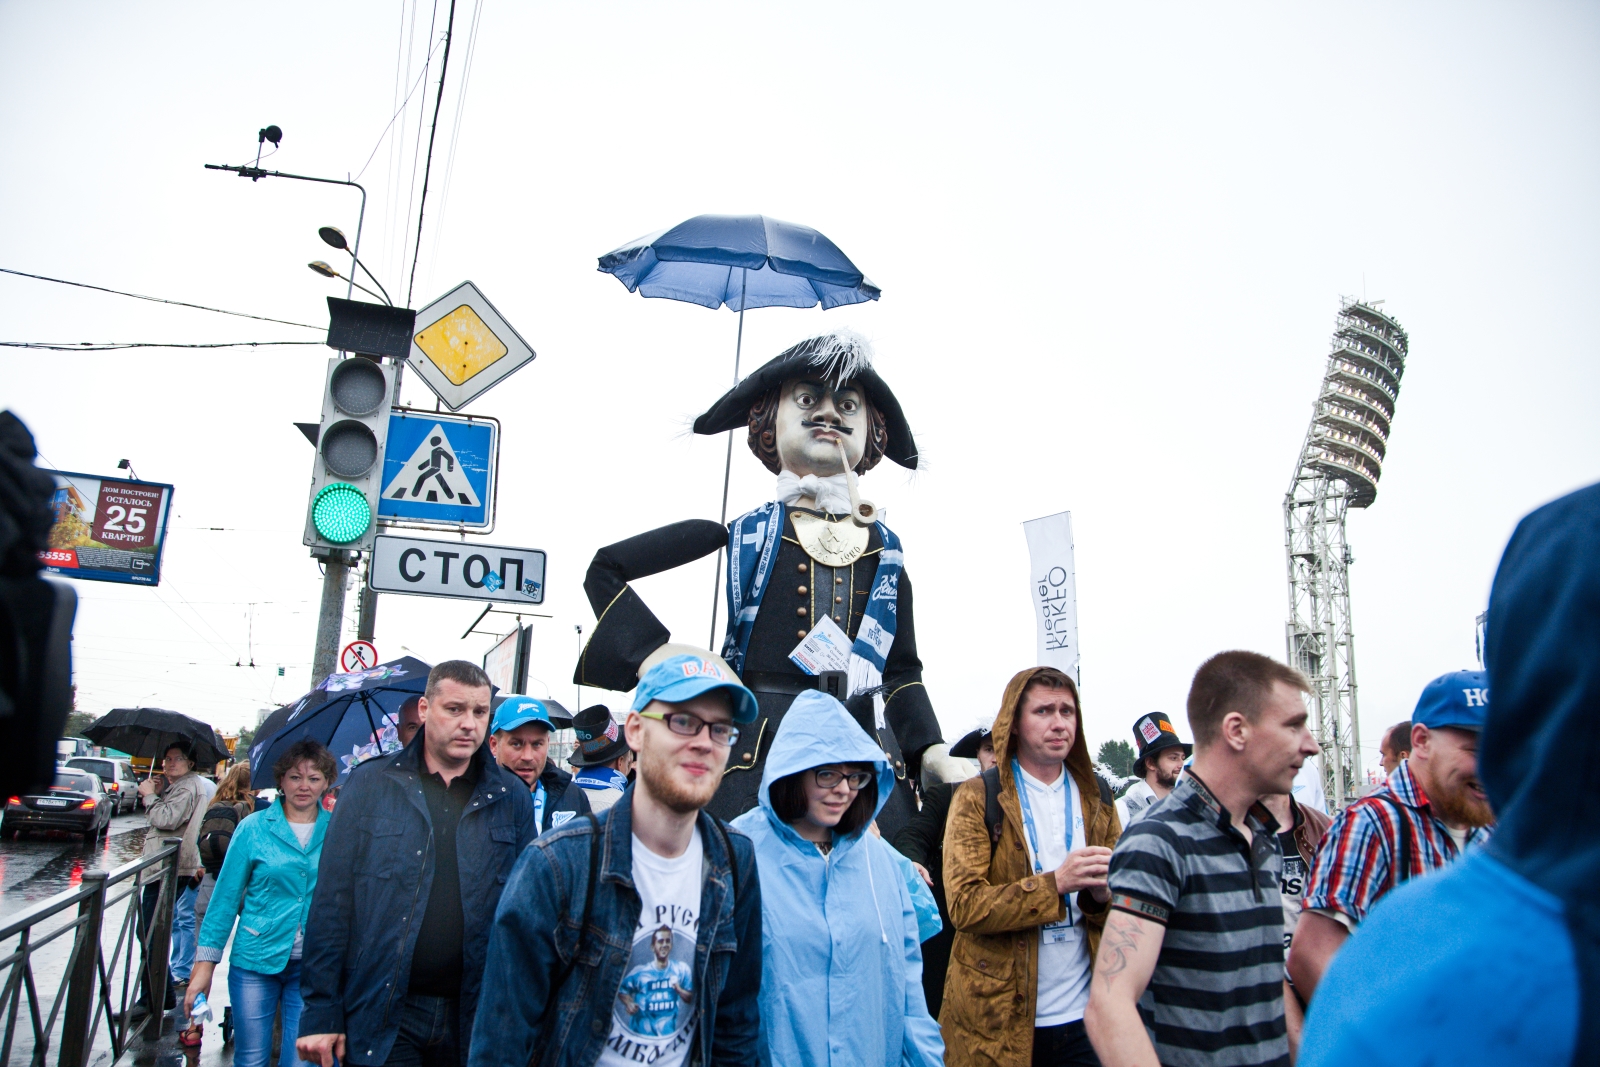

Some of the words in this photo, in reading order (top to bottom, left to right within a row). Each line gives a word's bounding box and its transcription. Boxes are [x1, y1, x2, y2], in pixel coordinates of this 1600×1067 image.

[120, 488, 159, 499] ПОСТРОЕН!
[106, 496, 153, 507] ОСТАЛОСЬ
[103, 505, 148, 534] 25
[101, 532, 145, 543] КВАРТИР
[398, 547, 524, 592] СТОП
[887, 602, 897, 615] 192
[1186, 777, 1213, 804] FERRARI
